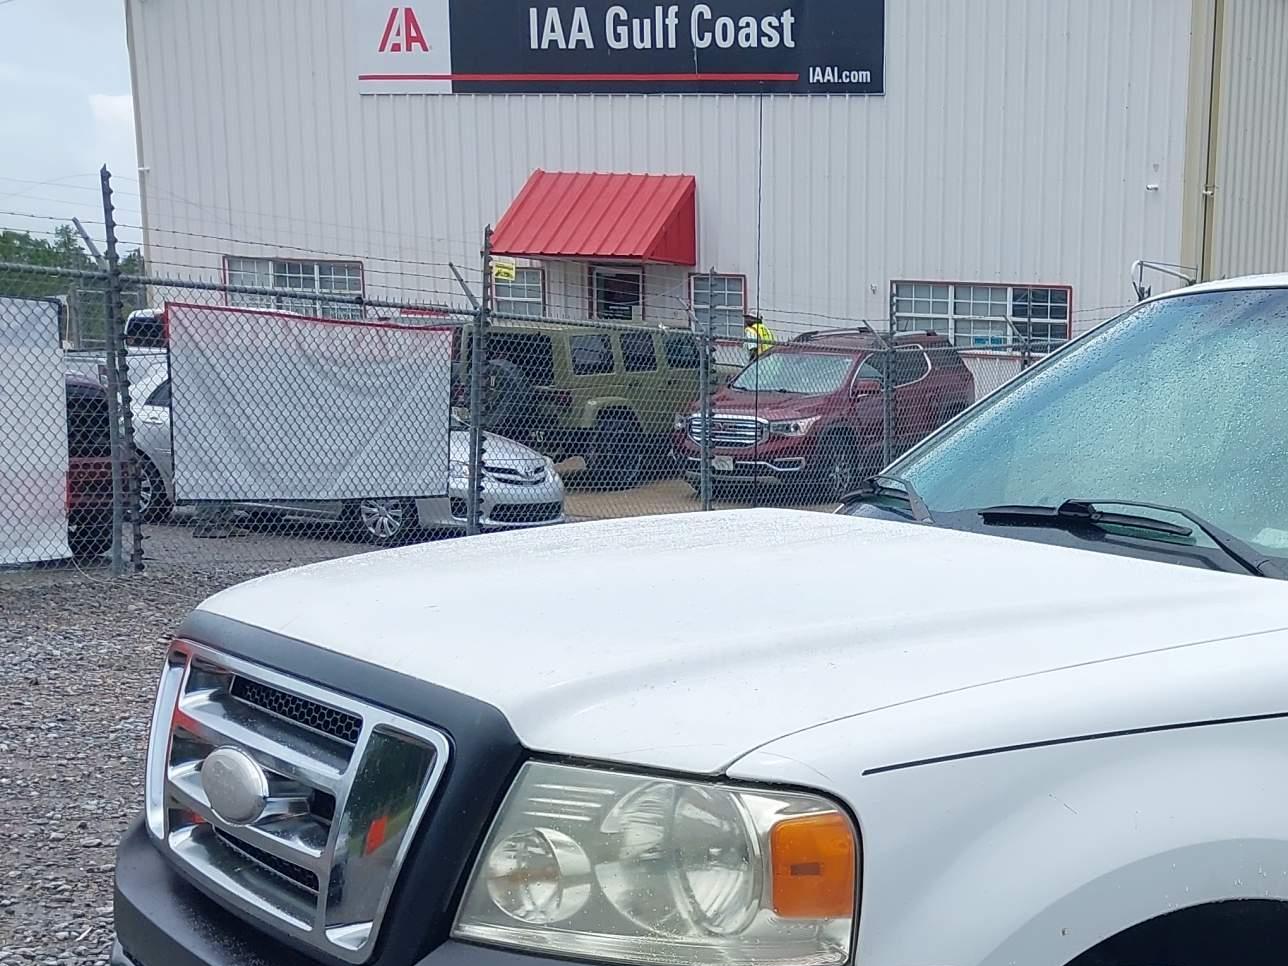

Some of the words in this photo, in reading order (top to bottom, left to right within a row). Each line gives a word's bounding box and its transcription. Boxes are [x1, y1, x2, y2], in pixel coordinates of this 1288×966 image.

[529, 7, 594, 49] IAA
[605, 5, 678, 49] Gulf
[690, 4, 795, 48] Coast
[809, 66, 871, 83] IAAI.com
